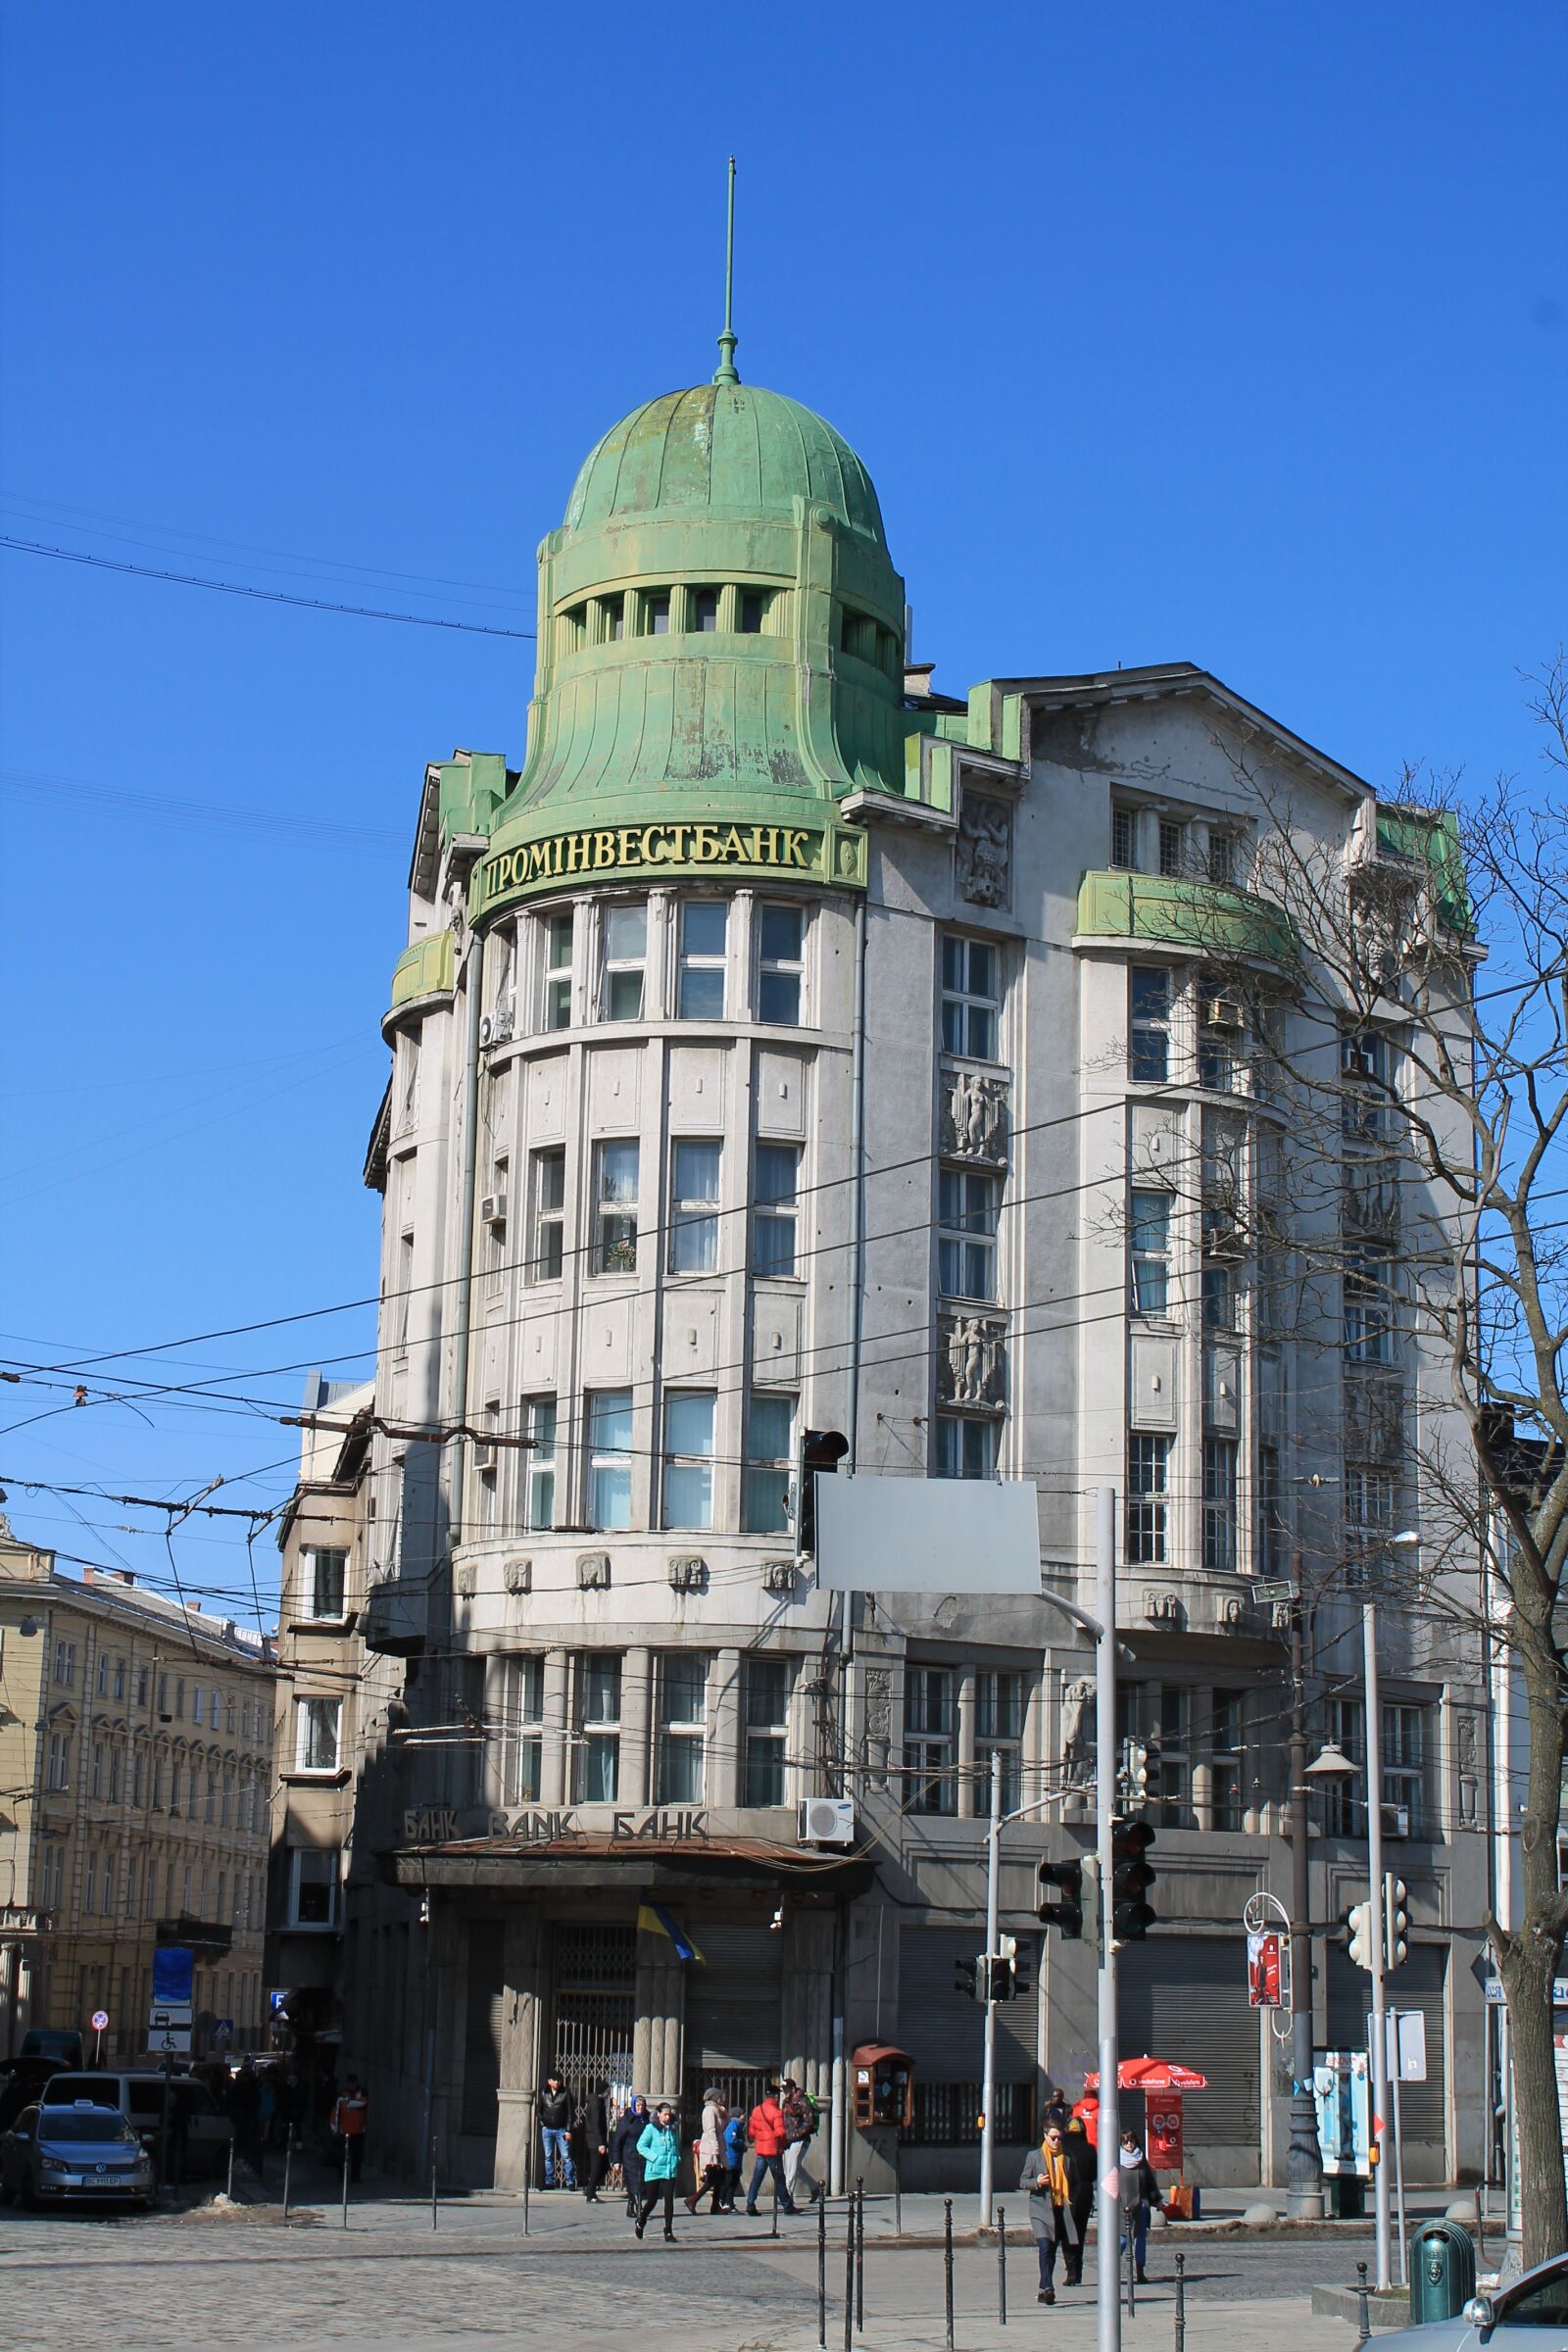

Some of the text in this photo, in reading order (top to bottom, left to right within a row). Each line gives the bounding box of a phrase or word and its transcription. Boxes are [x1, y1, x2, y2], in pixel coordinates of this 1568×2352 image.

[486, 825, 809, 899] ПРОМІНВЕСТБАНК
[404, 1810, 463, 1839] БАНК
[489, 1811, 577, 1840] BANK
[612, 1811, 710, 1841] БАНК
